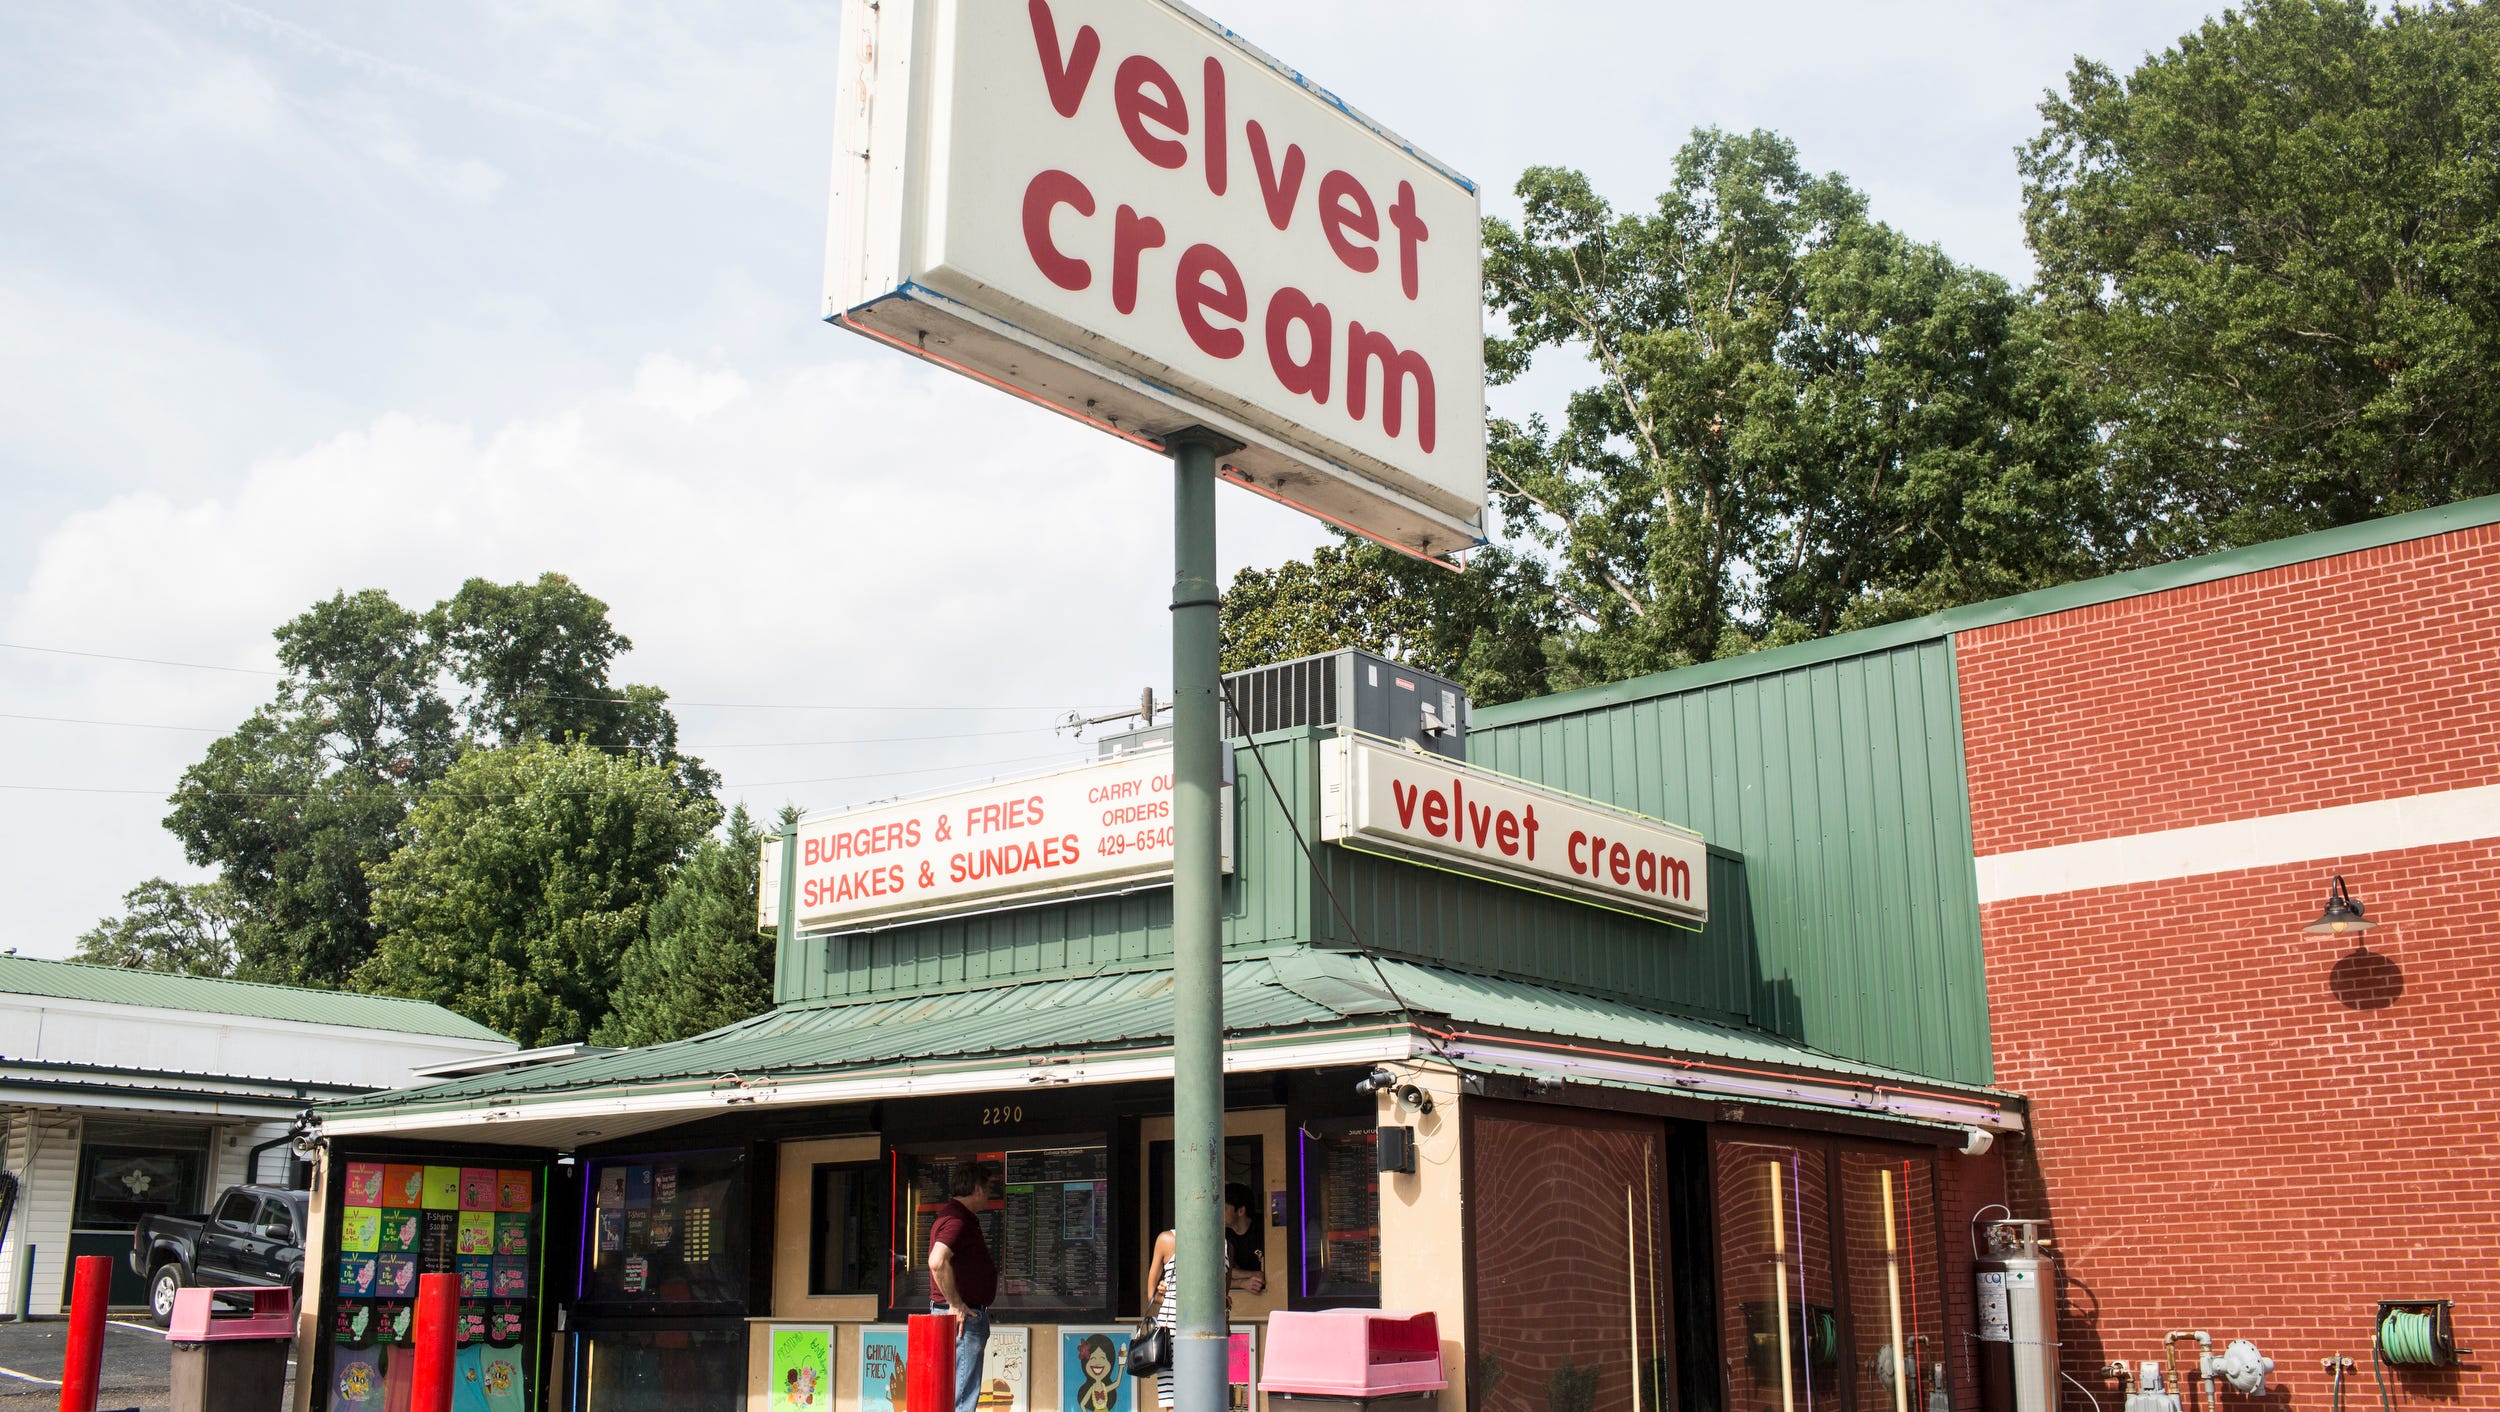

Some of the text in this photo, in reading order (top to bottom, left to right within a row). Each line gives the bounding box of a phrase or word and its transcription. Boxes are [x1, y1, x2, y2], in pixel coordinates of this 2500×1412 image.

[1028, 0, 1429, 301] velvet
[1021, 169, 1436, 455] cream
[1088, 774, 1175, 804] CARRY OU
[1102, 800, 1169, 827] ORDERS
[804, 795, 1045, 867] BURGERS & FRIES
[1097, 825, 1175, 857] 429-6540
[1391, 778, 1691, 901] velvet cream
[803, 833, 1081, 908] SHAKES & SUNDAES
[982, 1105, 1023, 1126] 2290
[426, 1213, 453, 1222] T-Shirts
[865, 1344, 897, 1362] CHICKEN
[865, 1363, 888, 1379] FRIES
